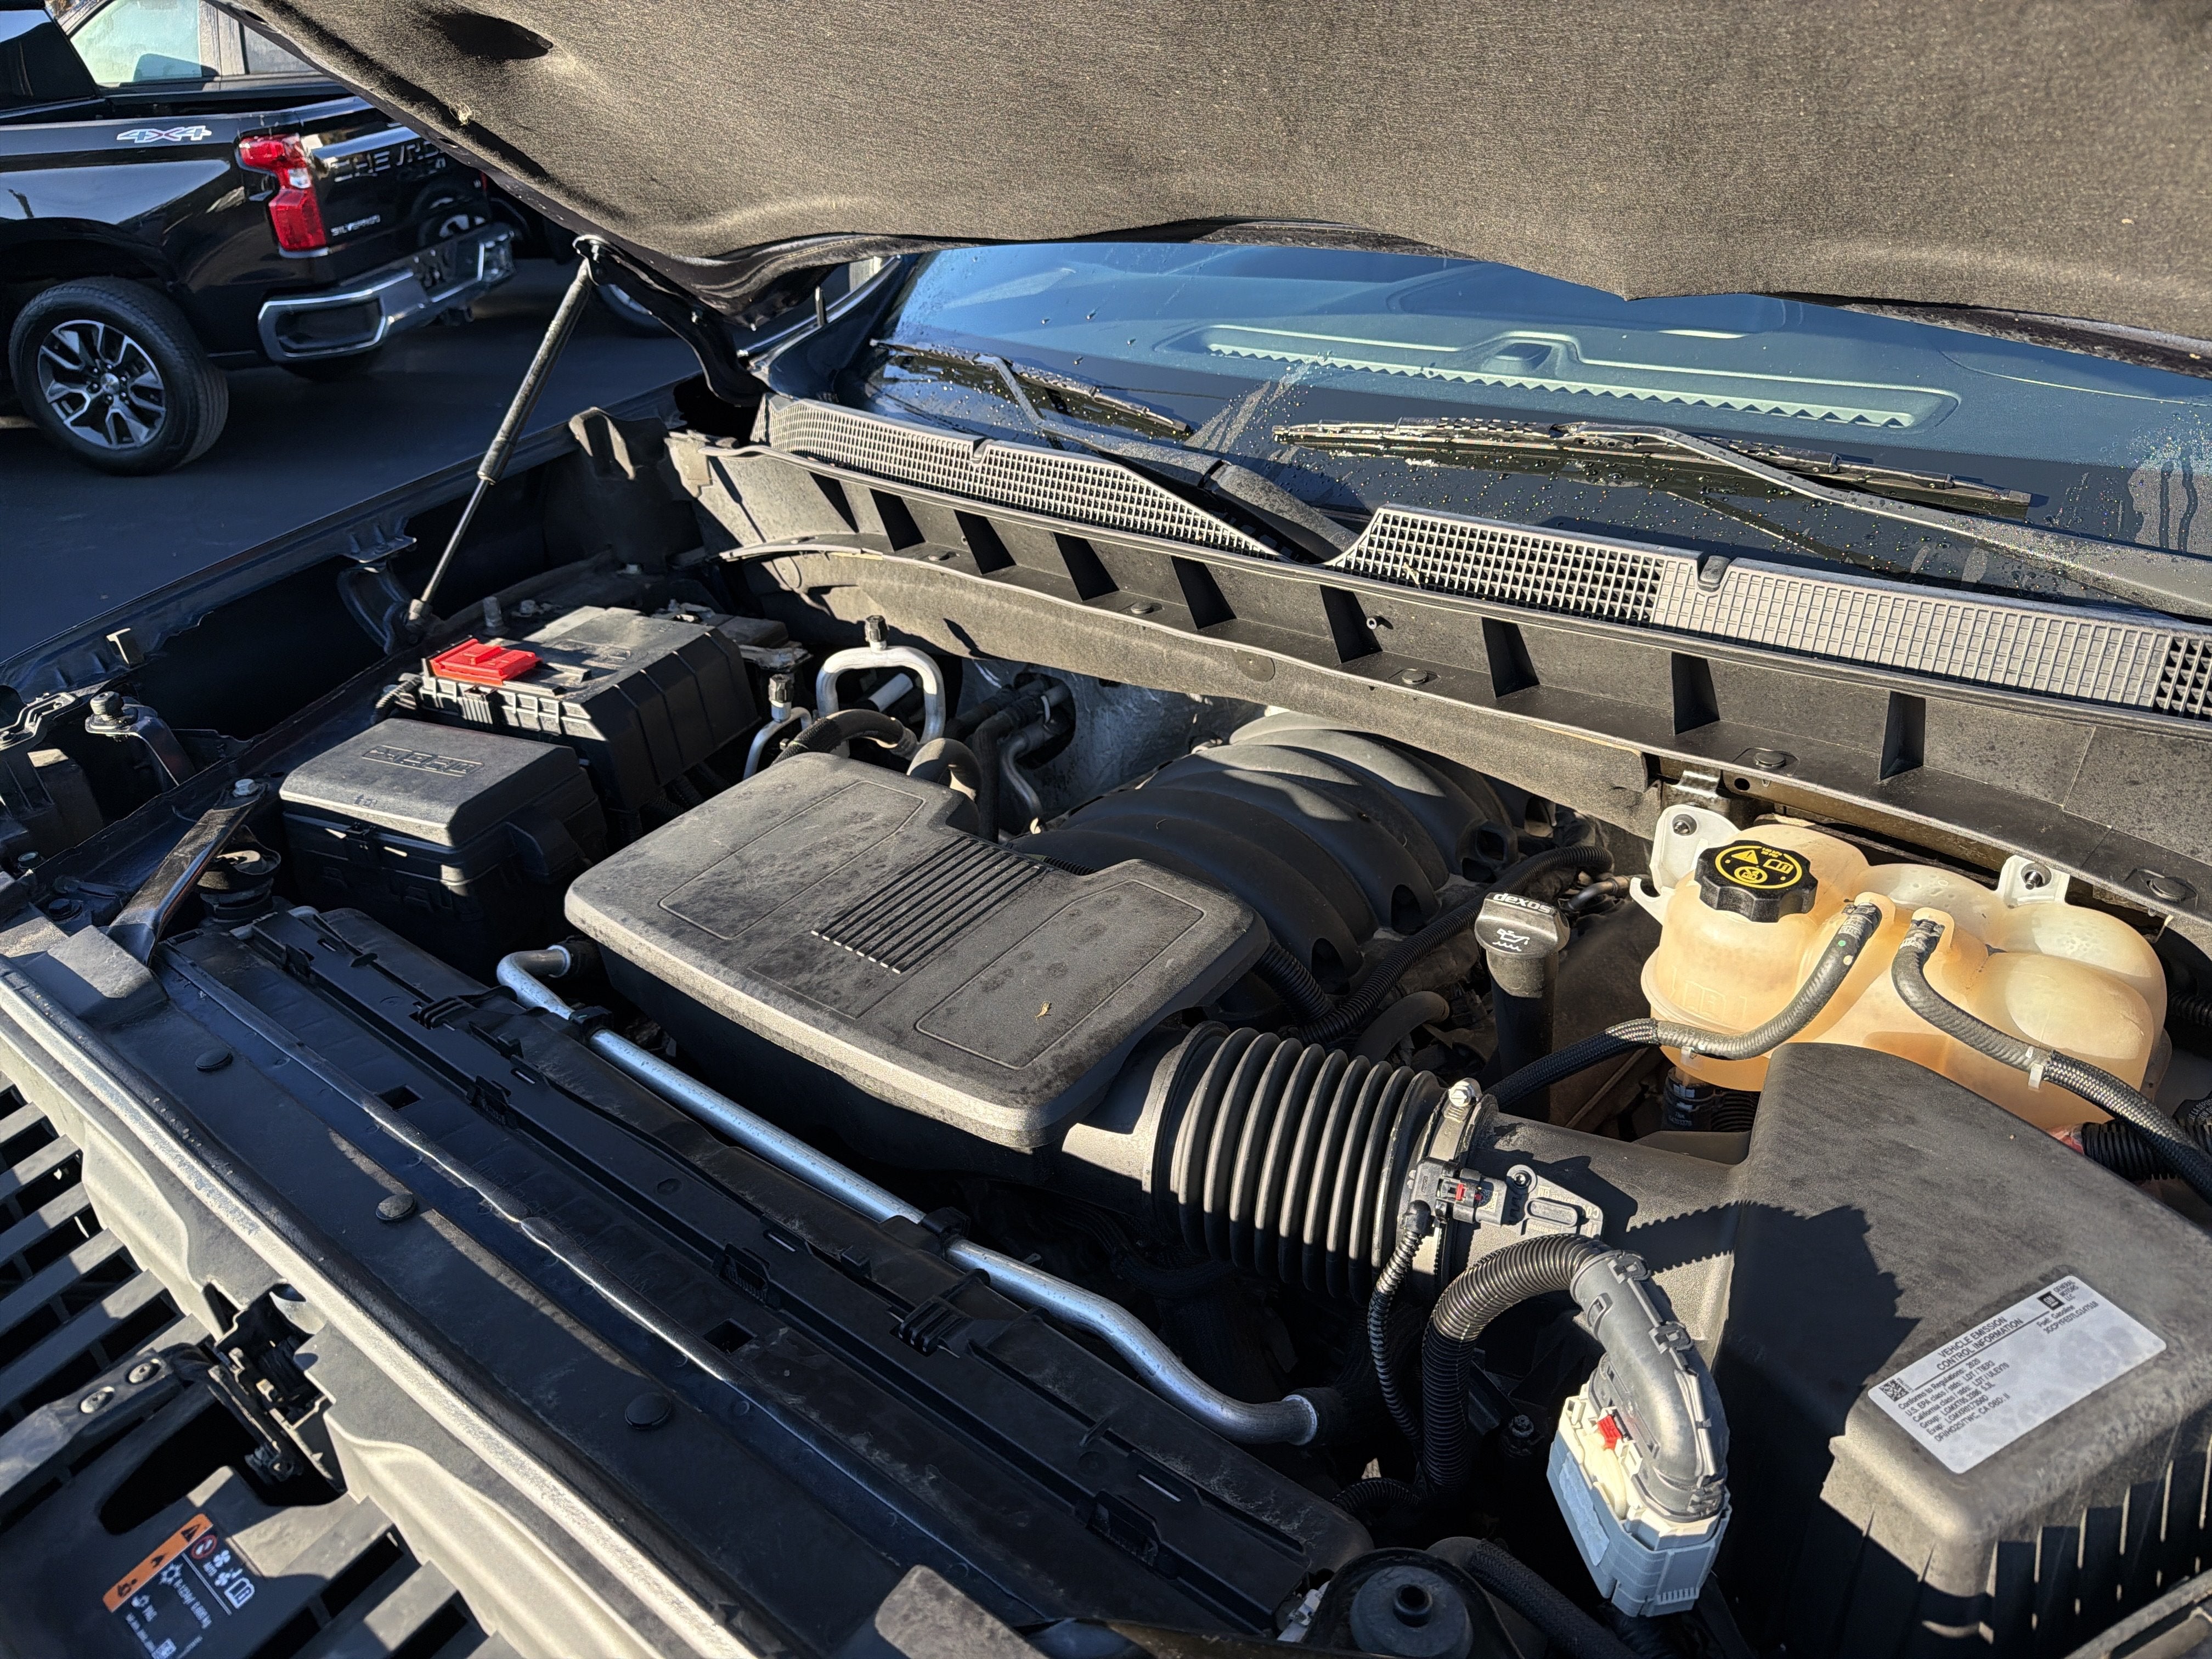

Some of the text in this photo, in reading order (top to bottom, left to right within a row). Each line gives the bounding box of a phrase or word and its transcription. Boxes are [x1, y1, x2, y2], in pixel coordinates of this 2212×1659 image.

[1493, 893, 1551, 913] dexos
[1537, 1186, 1550, 1198] GM
[2053, 1280, 2074, 1291] GENERAL
[2059, 1285, 2078, 1296] MOTORS
[2036, 1305, 2075, 1327] Fuel: Gasoline
[1936, 1318, 2023, 1370] CONTROL INFORMATION
[1938, 1317, 2006, 1357] VEHICLE EMISSION
[1898, 1391, 1926, 1409] Conforms
[1930, 1367, 1966, 1389] Regulations:
[1966, 1359, 1980, 1368] 2020
[1905, 1406, 1918, 1415] U.S.
[1917, 1399, 1931, 1408] EPA
[1929, 1390, 1945, 1400] class
[1946, 1380, 1962, 1390] stds:
[1962, 1372, 1976, 1380] LDT
[1977, 1361, 1995, 1372] TIER3
[1912, 1404, 1940, 1421] California
[1938, 1395, 1955, 1406] class
[1956, 1385, 1972, 1395] stds:
[1972, 1377, 1985, 1385] LDT
[1987, 1363, 2009, 1376] ULEV70
[1919, 1414, 1941, 1428] Group:
[1981, 1381, 1995, 1390] 5.3L
[1988, 1396, 2005, 1407] OBD:
[1926, 1423, 1944, 1434] Evap:
